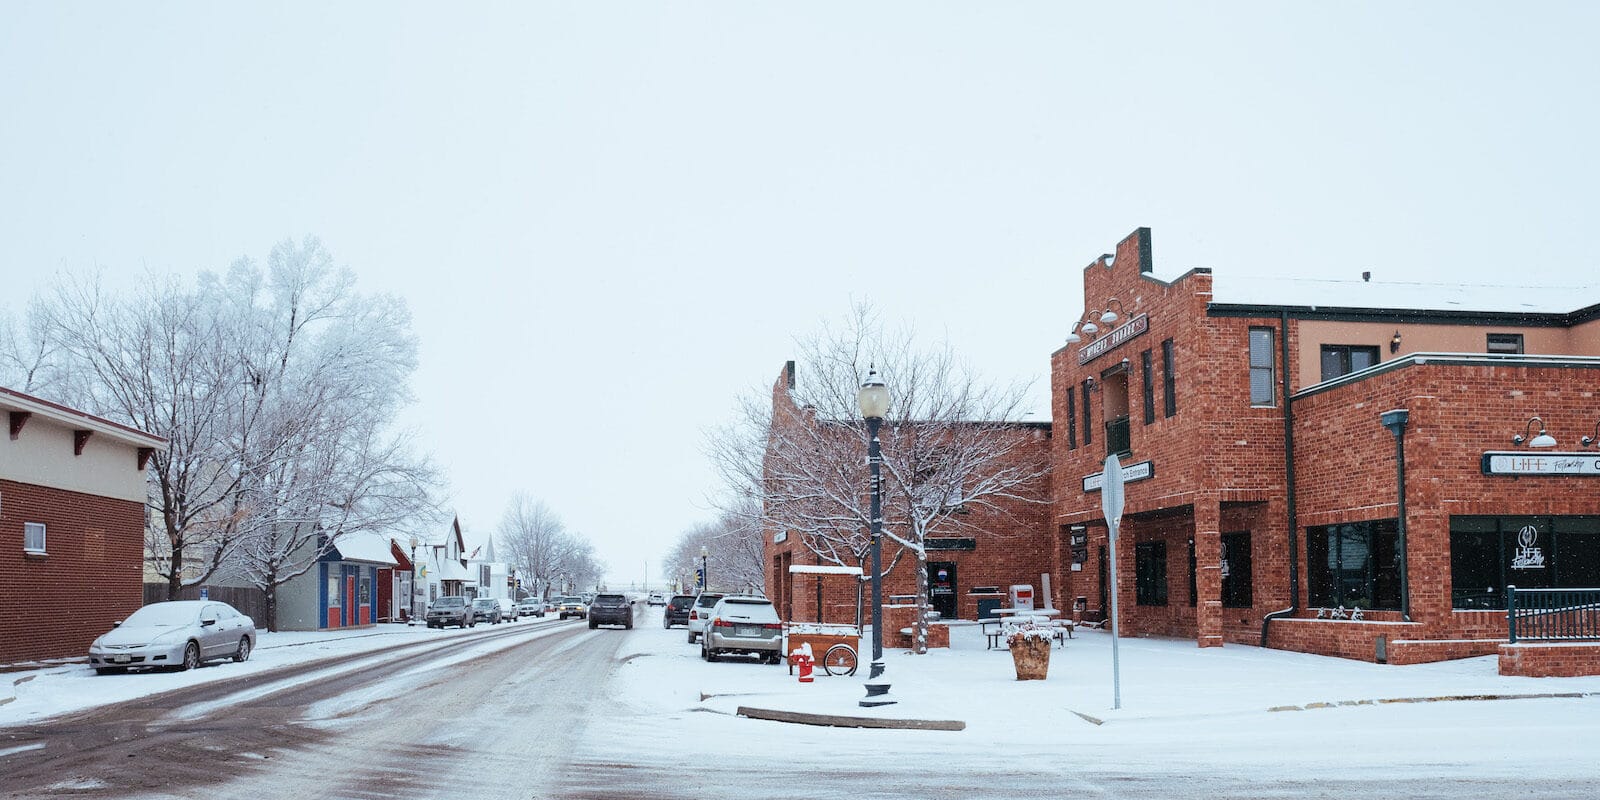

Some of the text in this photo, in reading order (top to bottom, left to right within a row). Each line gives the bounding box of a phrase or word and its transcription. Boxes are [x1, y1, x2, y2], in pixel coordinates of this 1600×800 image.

[1512, 458, 1547, 471] LIFE
[1129, 466, 1148, 478] Entrance
[1515, 547, 1541, 558] LIFE
